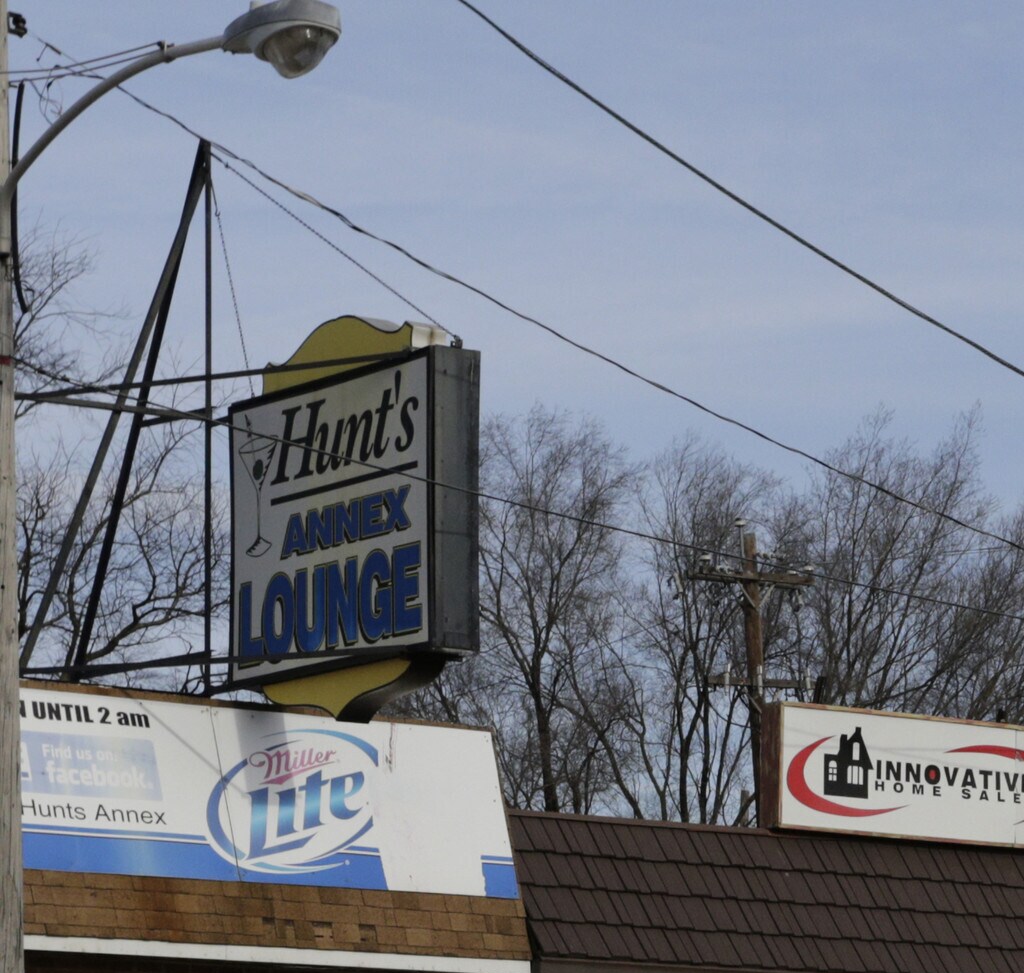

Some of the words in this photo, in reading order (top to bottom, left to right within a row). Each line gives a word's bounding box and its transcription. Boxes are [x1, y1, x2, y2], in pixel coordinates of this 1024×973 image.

[271, 370, 418, 486] Hunt's
[280, 484, 411, 560] ANNEX
[239, 541, 422, 667] LOUNGE
[32, 701, 94, 723] UNTIL
[98, 706, 111, 724] 2
[116, 711, 150, 729] am
[42, 743, 72, 759] Find
[76, 748, 93, 761] us
[250, 748, 336, 779] Miller
[874, 781, 943, 798] HOME
[21, 799, 86, 821] Hunts
[95, 803, 167, 825] Annex
[246, 769, 365, 861] Lite
